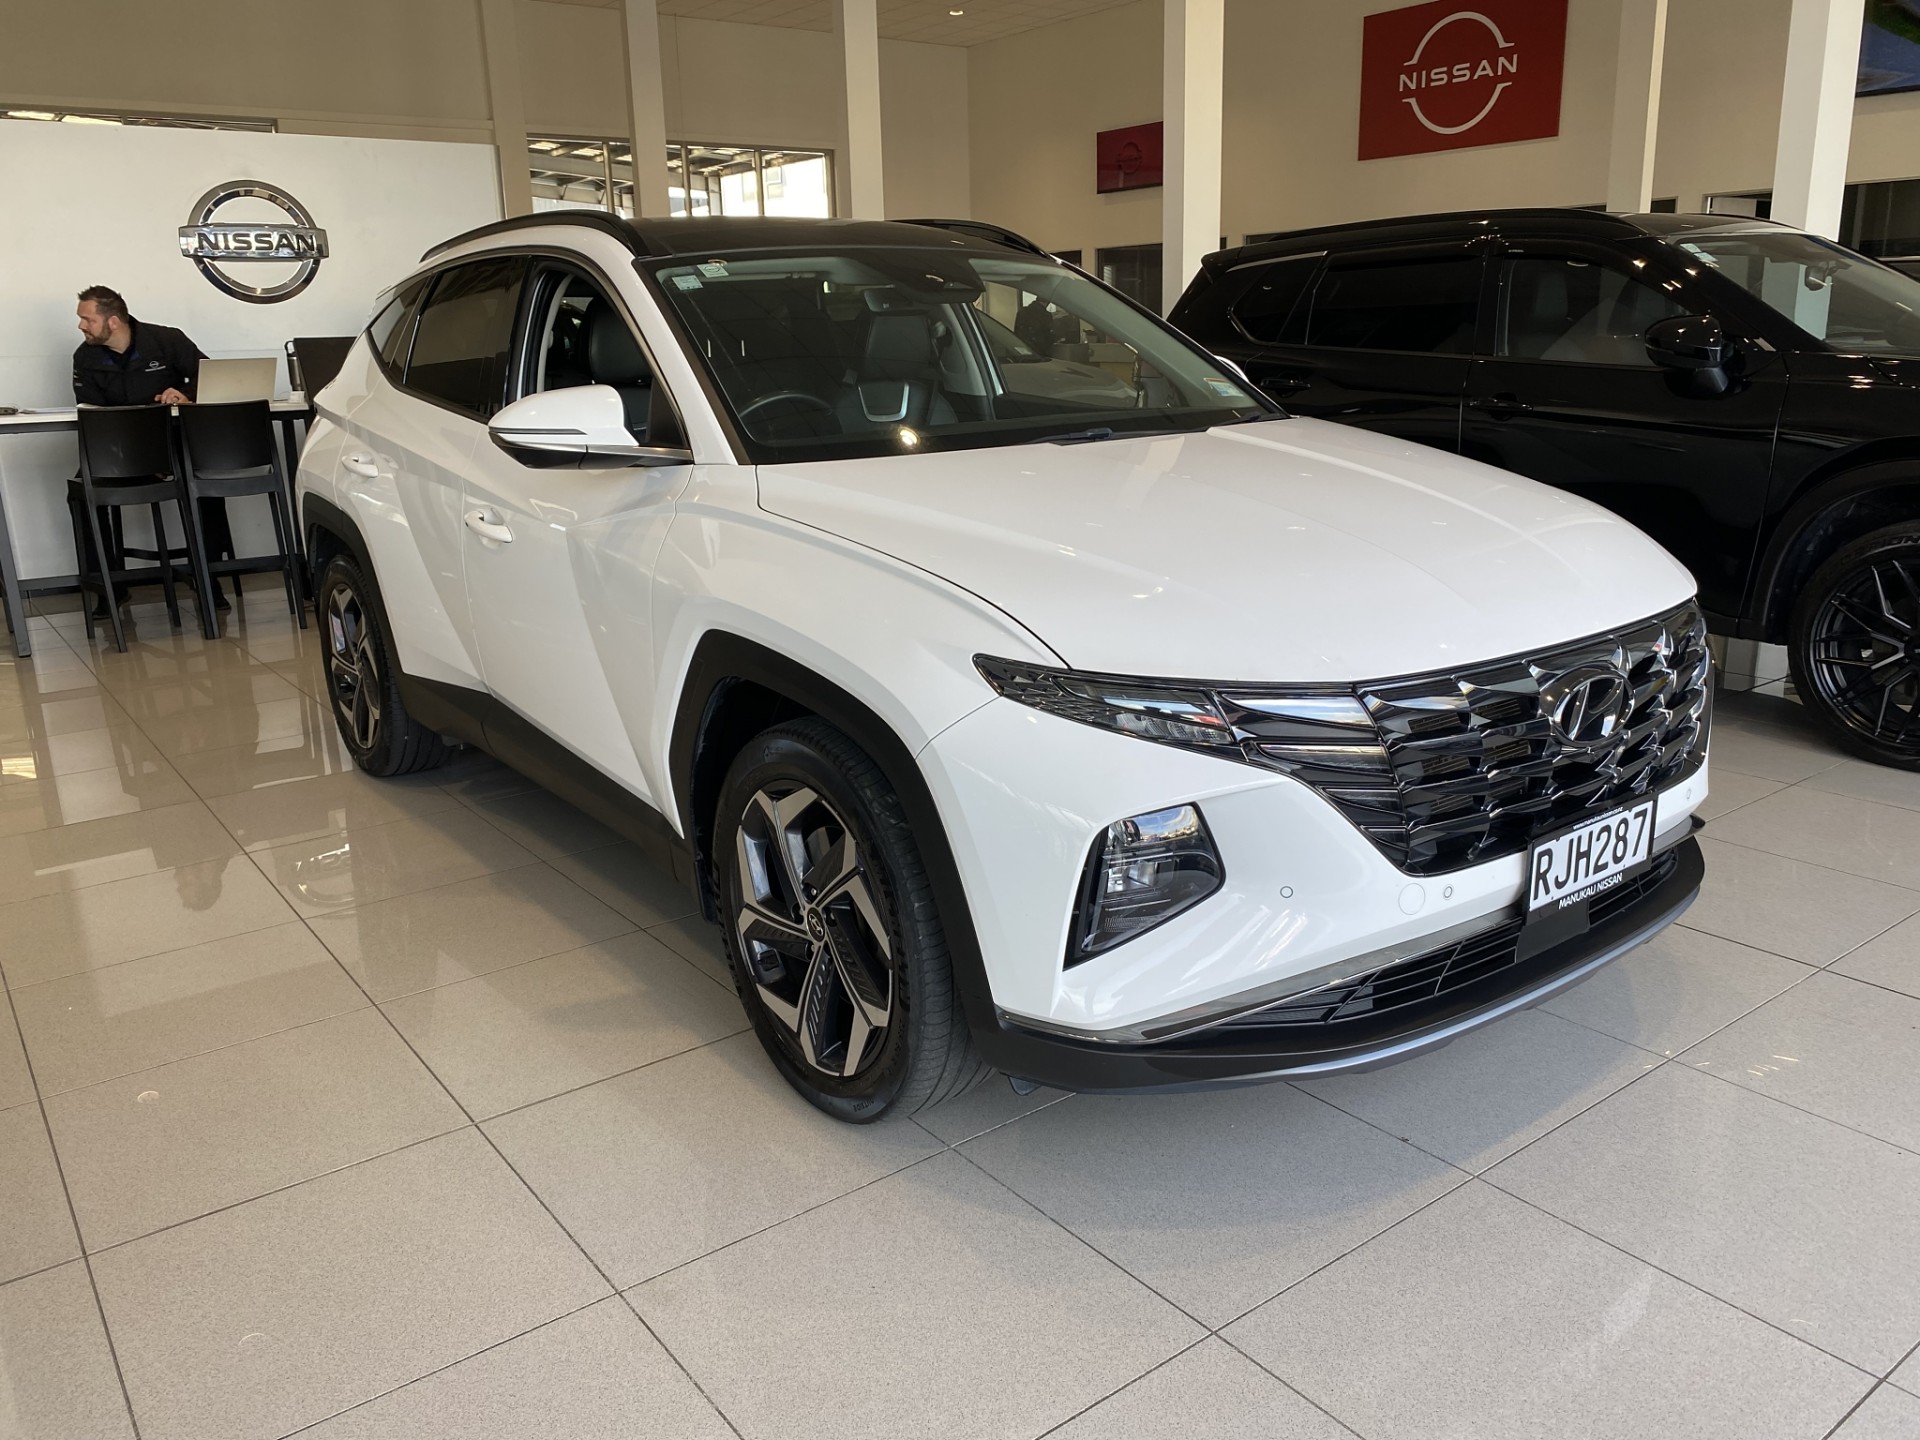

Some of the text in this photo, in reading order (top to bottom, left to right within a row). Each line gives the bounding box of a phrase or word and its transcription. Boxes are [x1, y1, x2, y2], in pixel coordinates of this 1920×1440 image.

[1399, 54, 1518, 92] NISSAN
[196, 231, 316, 253] NISSAN
[1533, 807, 1648, 901] RJH287
[1558, 872, 1623, 910] MANUKAU NISSAN
